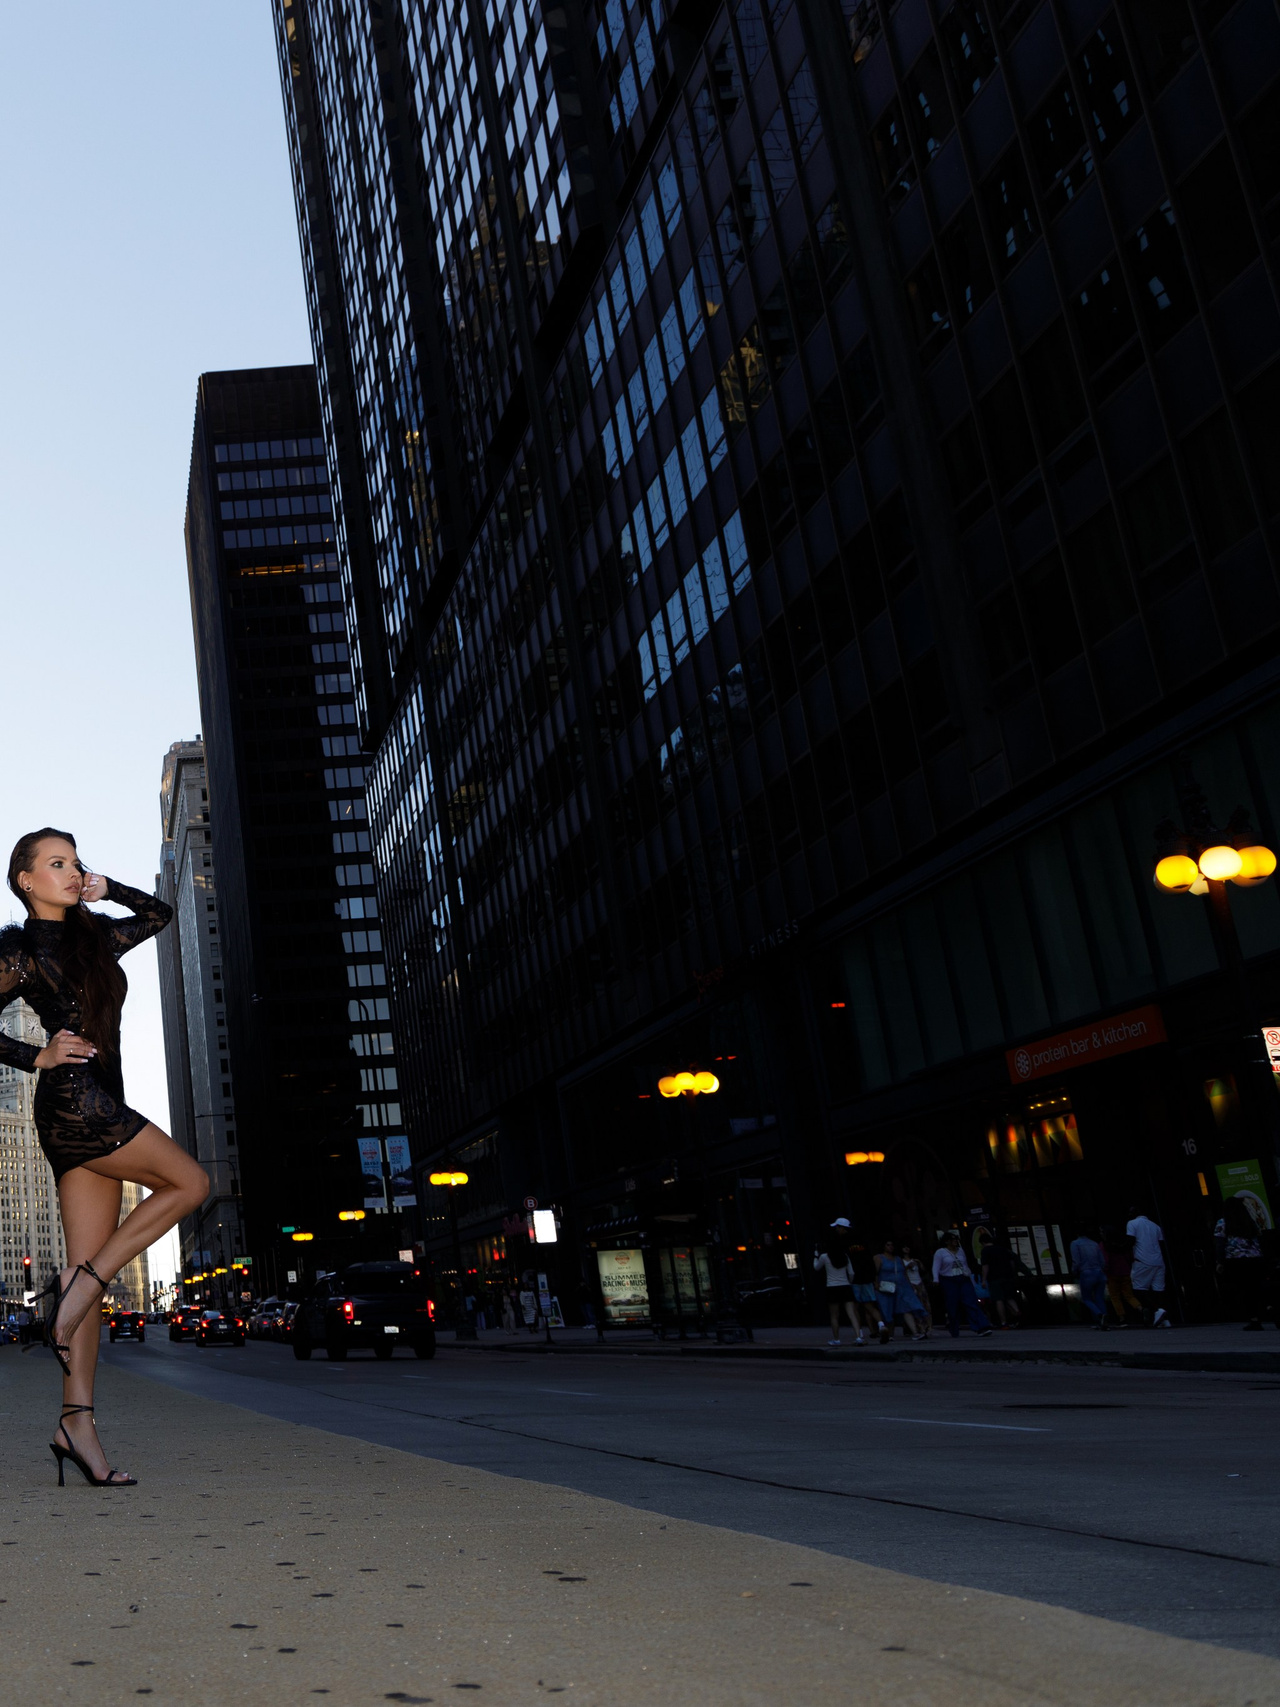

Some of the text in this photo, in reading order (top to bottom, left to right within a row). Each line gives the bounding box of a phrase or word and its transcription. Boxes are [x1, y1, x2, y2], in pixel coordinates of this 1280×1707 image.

[748, 919, 799, 960] FITNESS
[1032, 1021, 1147, 1070] protein bar & kitchen
[1181, 1137, 1197, 1155] 16
[527, 1199, 535, 1209] B
[602, 1280, 626, 1288] RACING
[630, 1279, 647, 1287] MUSI
[604, 1273, 646, 1281] SUMMER
